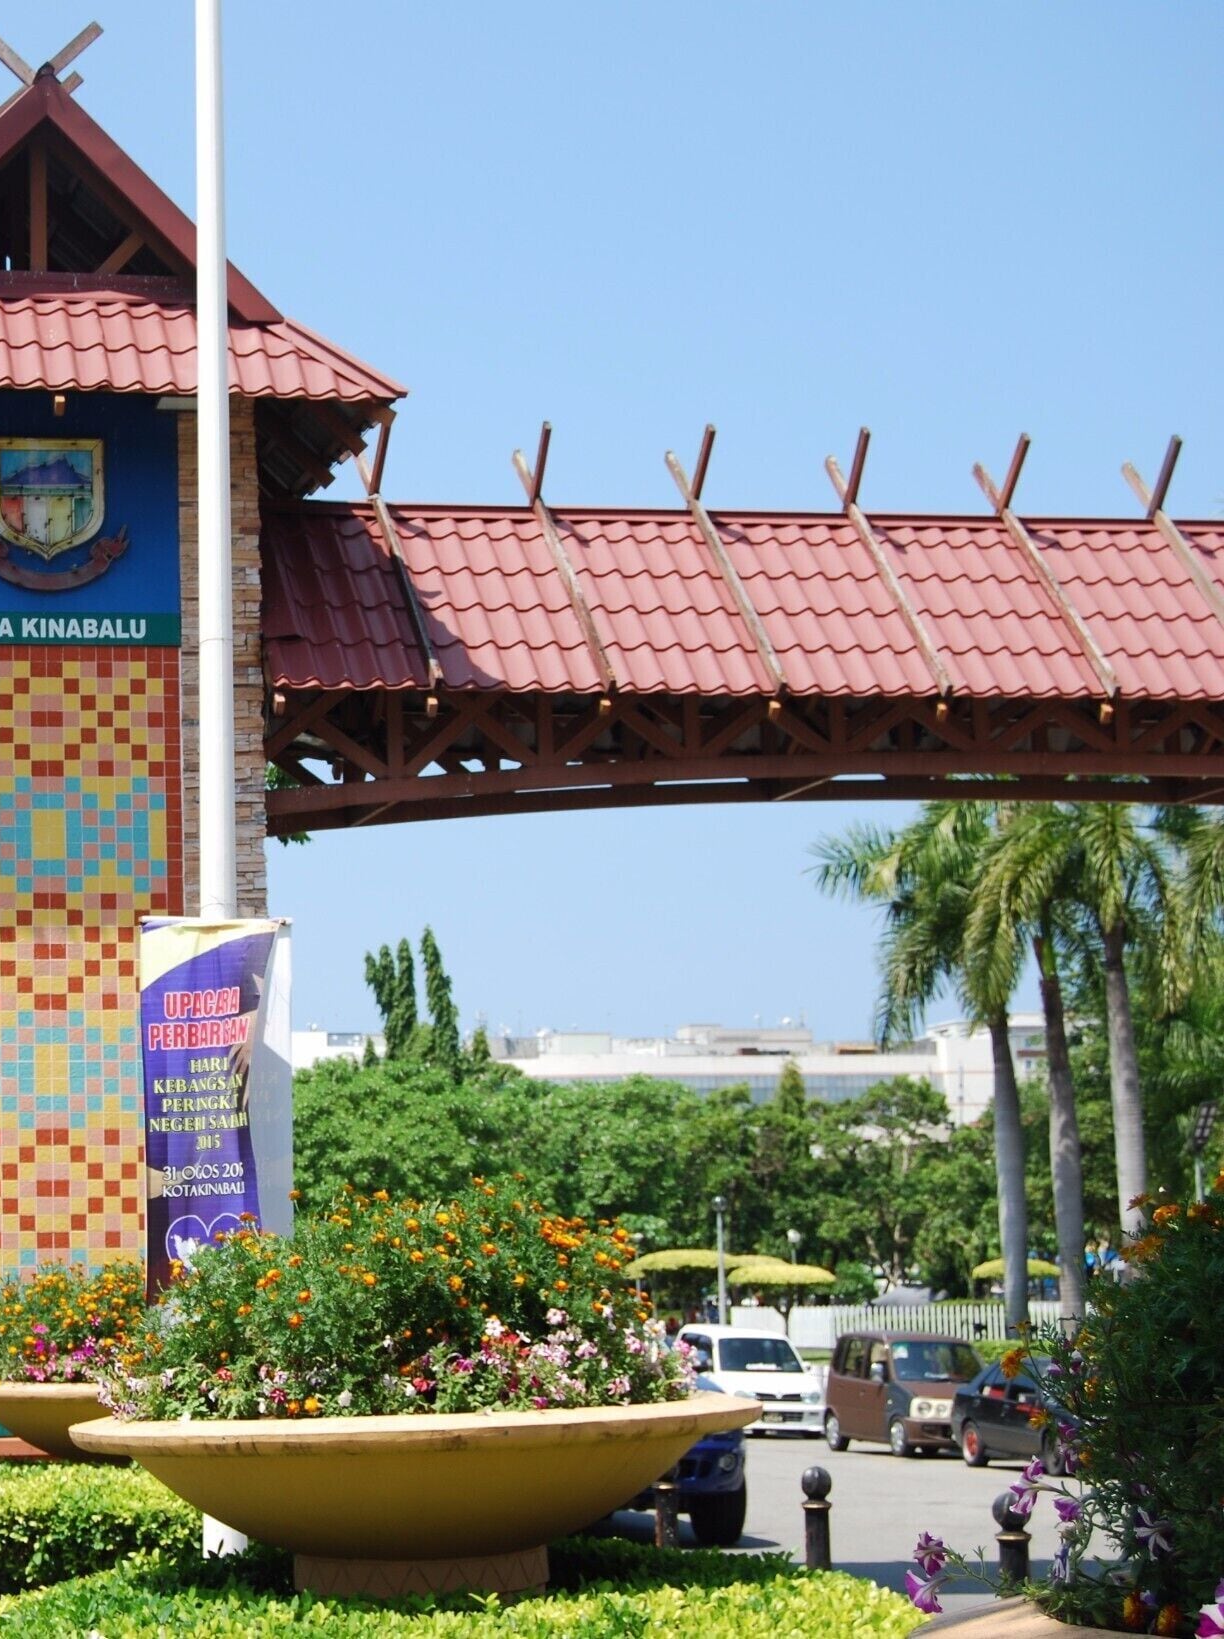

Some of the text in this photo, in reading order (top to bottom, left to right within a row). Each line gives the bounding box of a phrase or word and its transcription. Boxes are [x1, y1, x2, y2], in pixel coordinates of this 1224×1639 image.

[22, 617, 147, 639] KINABALU
[163, 986, 240, 1019] UPACARA
[148, 1017, 250, 1051] PERBARSAN
[189, 1057, 229, 1073] HARI
[153, 1073, 243, 1094] KEBANGSAN
[161, 1094, 239, 1112] PERINGKT
[162, 1166, 176, 1181] 31
[181, 1163, 219, 1180] OGOS
